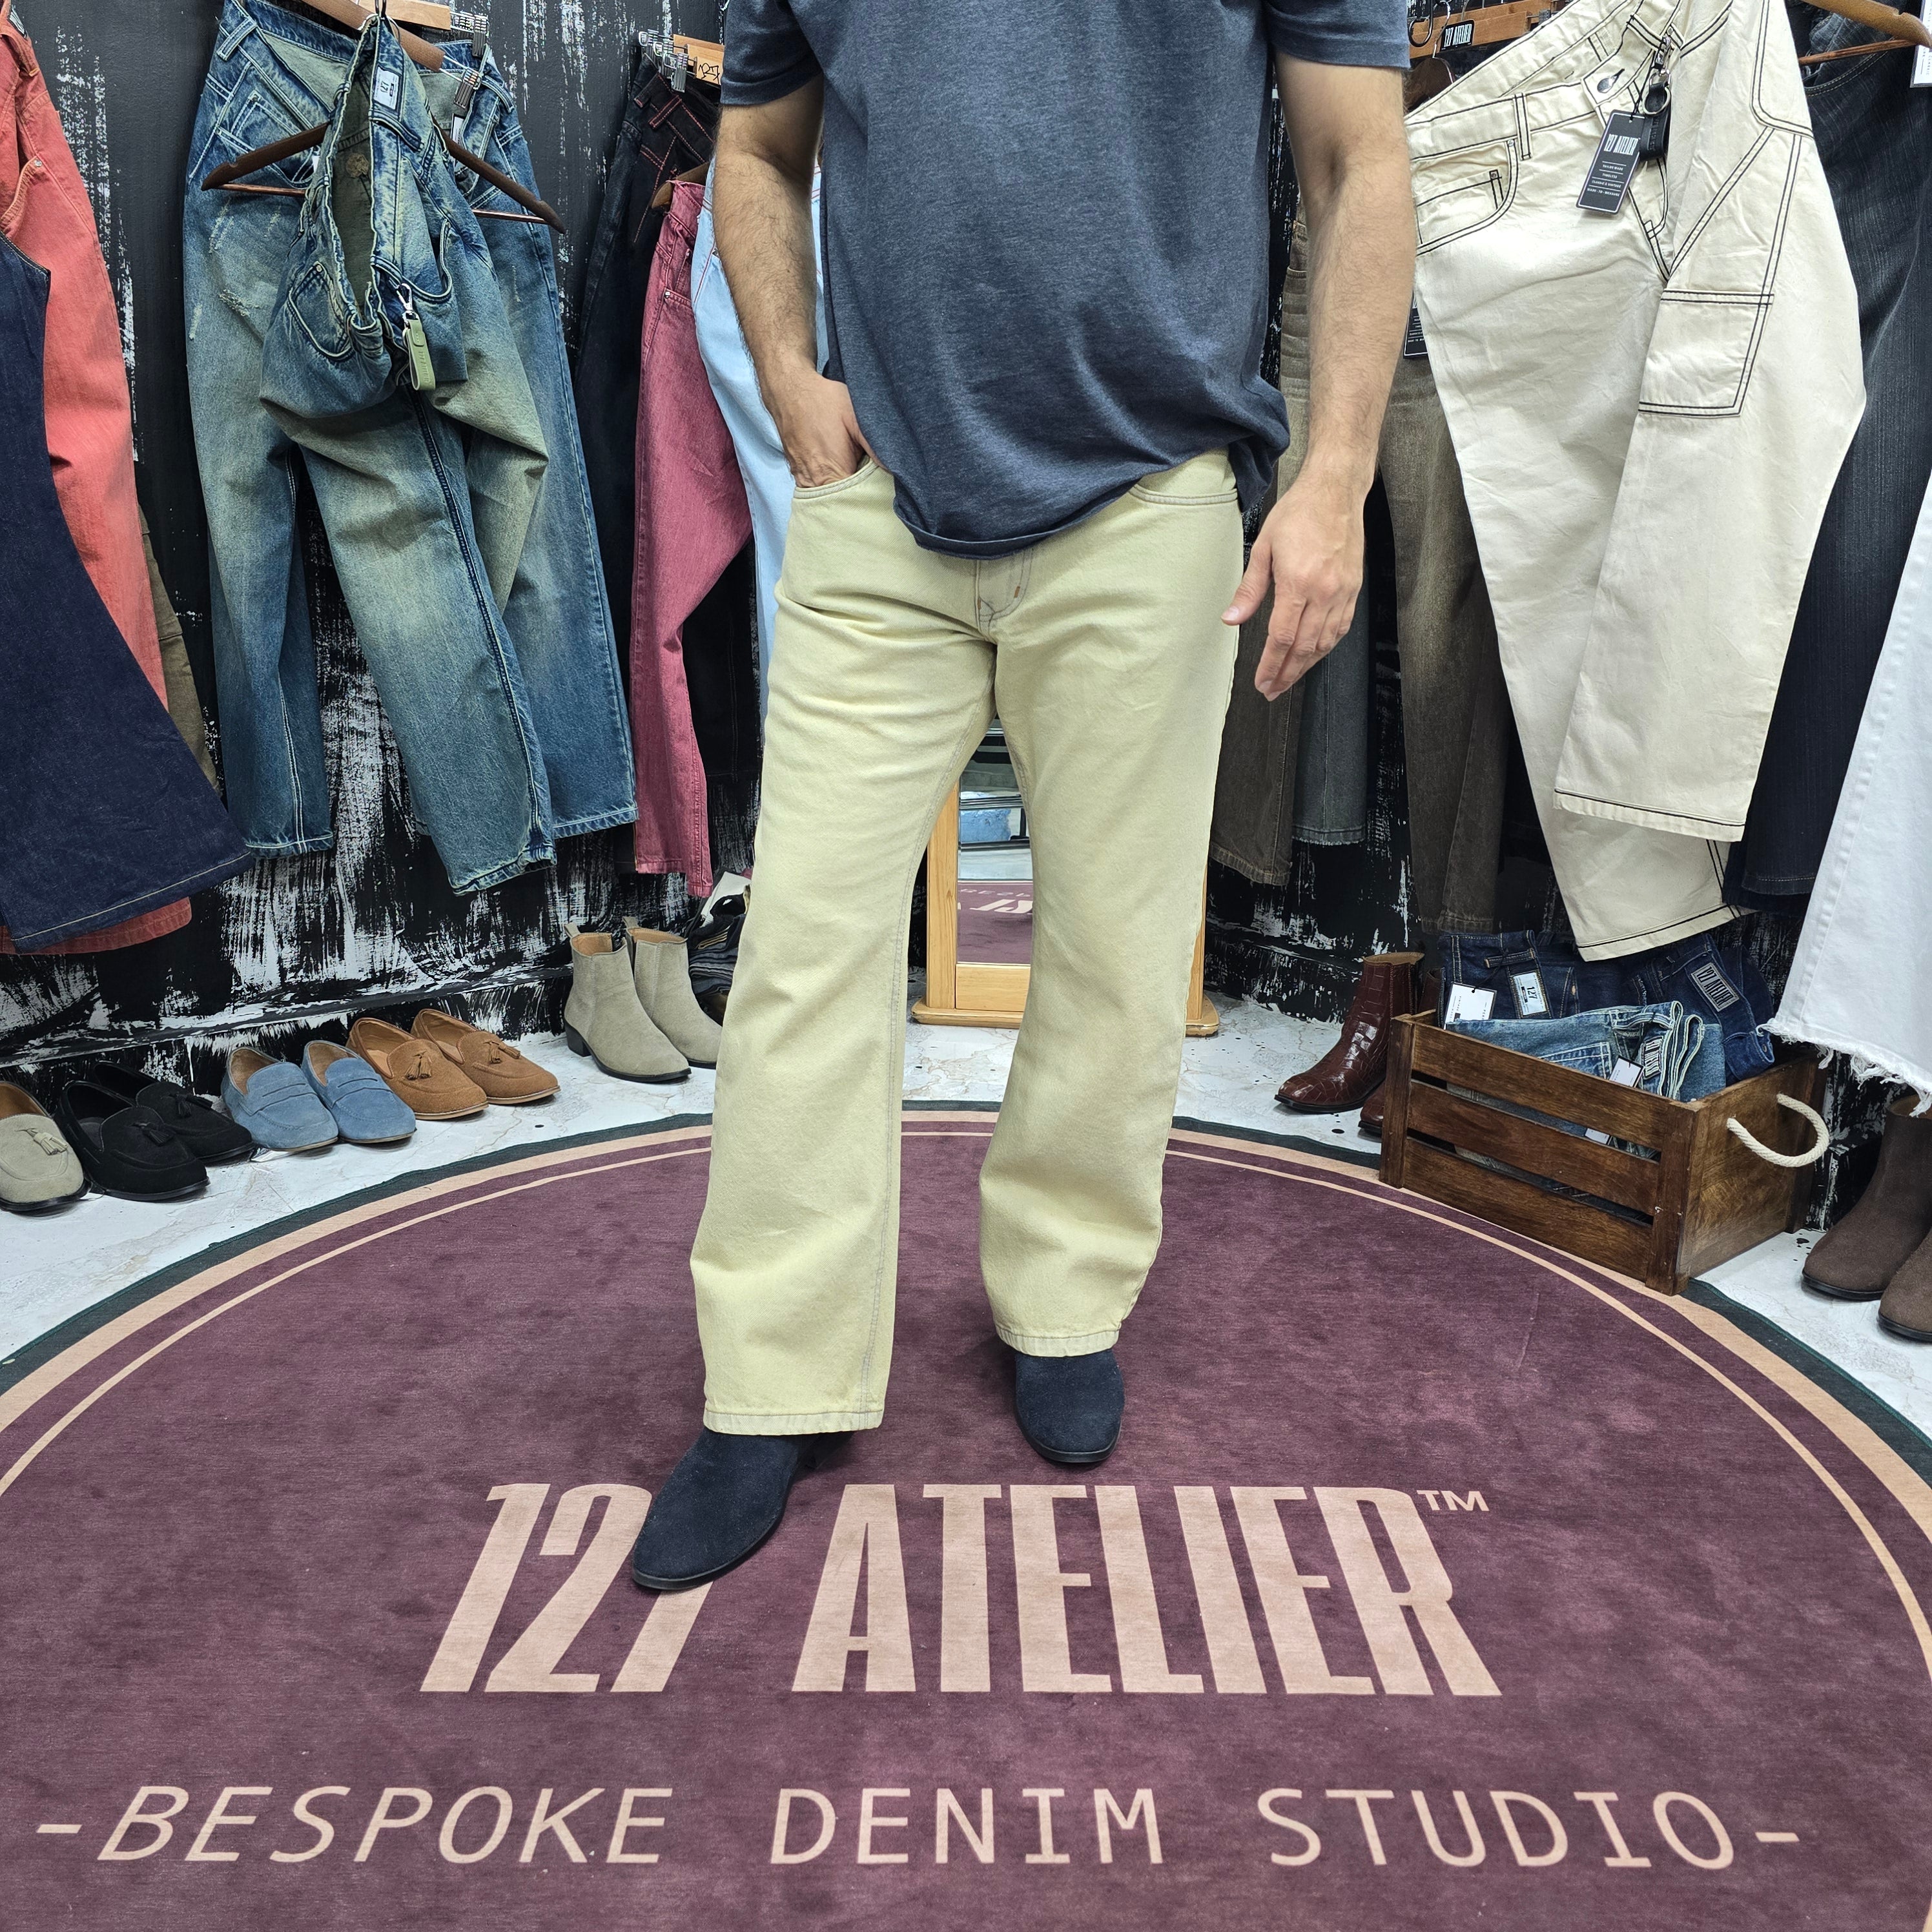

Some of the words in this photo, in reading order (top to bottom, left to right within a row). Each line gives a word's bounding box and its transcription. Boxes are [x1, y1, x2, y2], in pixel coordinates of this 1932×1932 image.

[1452, 24, 1472, 46] ATELIER
[1604, 134, 1618, 152] 127
[1696, 967, 1717, 983] 127
[1526, 986, 1538, 1000] 127
[1704, 978, 1734, 1006] ATELIER
[770, 1787, 1164, 1865] DENIM
